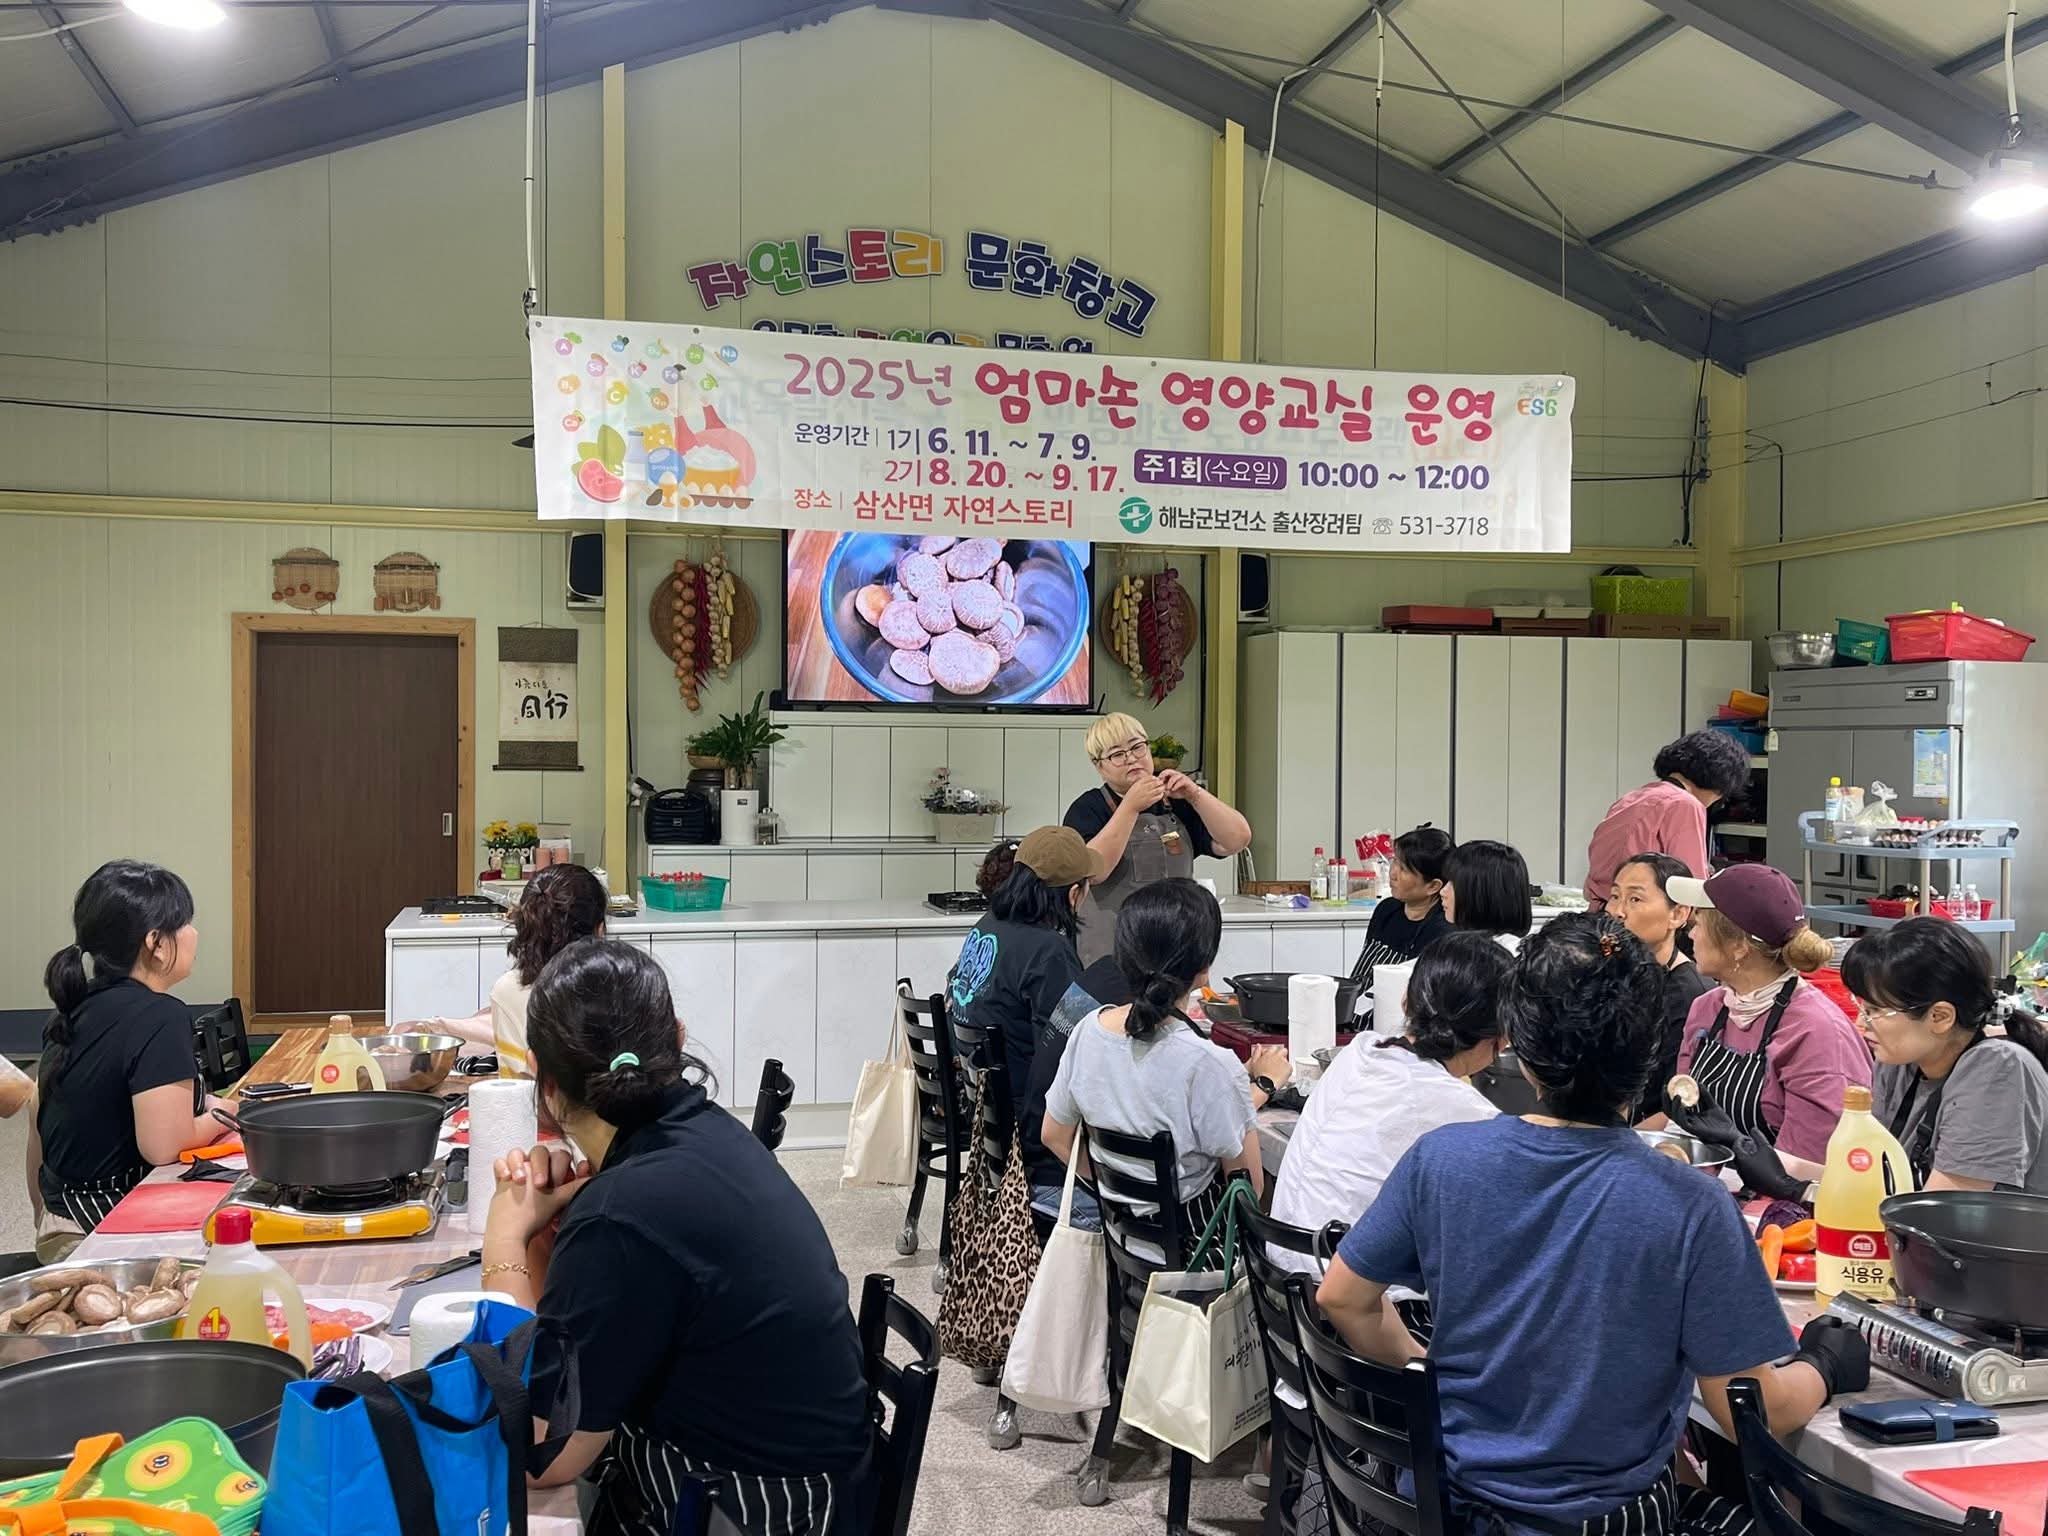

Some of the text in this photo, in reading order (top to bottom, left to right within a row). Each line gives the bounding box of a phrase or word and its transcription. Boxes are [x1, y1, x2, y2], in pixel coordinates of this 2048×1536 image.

[687, 228, 1157, 337] 자연스토리 문화창고
[784, 353, 952, 406] 2025년
[975, 362, 1138, 429] 엄마손
[1161, 372, 1373, 442] 영양교실
[1405, 384, 1495, 446] 운영
[794, 422, 870, 447] 운영기간
[887, 428, 920, 455] 1기
[928, 427, 956, 455] 6.
[965, 429, 998, 457] 11.
[1038, 433, 1062, 460] 7.
[1071, 433, 1097, 461] 9.
[884, 459, 921, 487] 2기
[929, 457, 957, 486] 8.
[966, 460, 1014, 489] 20.
[1052, 463, 1079, 491] 9.
[1087, 465, 1125, 493] 17.
[1141, 453, 1280, 486] 주1회(수요일)
[1298, 461, 1379, 489] 10:00
[1415, 464, 1490, 490] 12:00
[794, 489, 1073, 529] 장소 삼산면 자연스토리
[1158, 505, 1490, 537] 해남군보건소 출산장려팀 531-3718
[1841, 1266, 1885, 1284] 식용유
